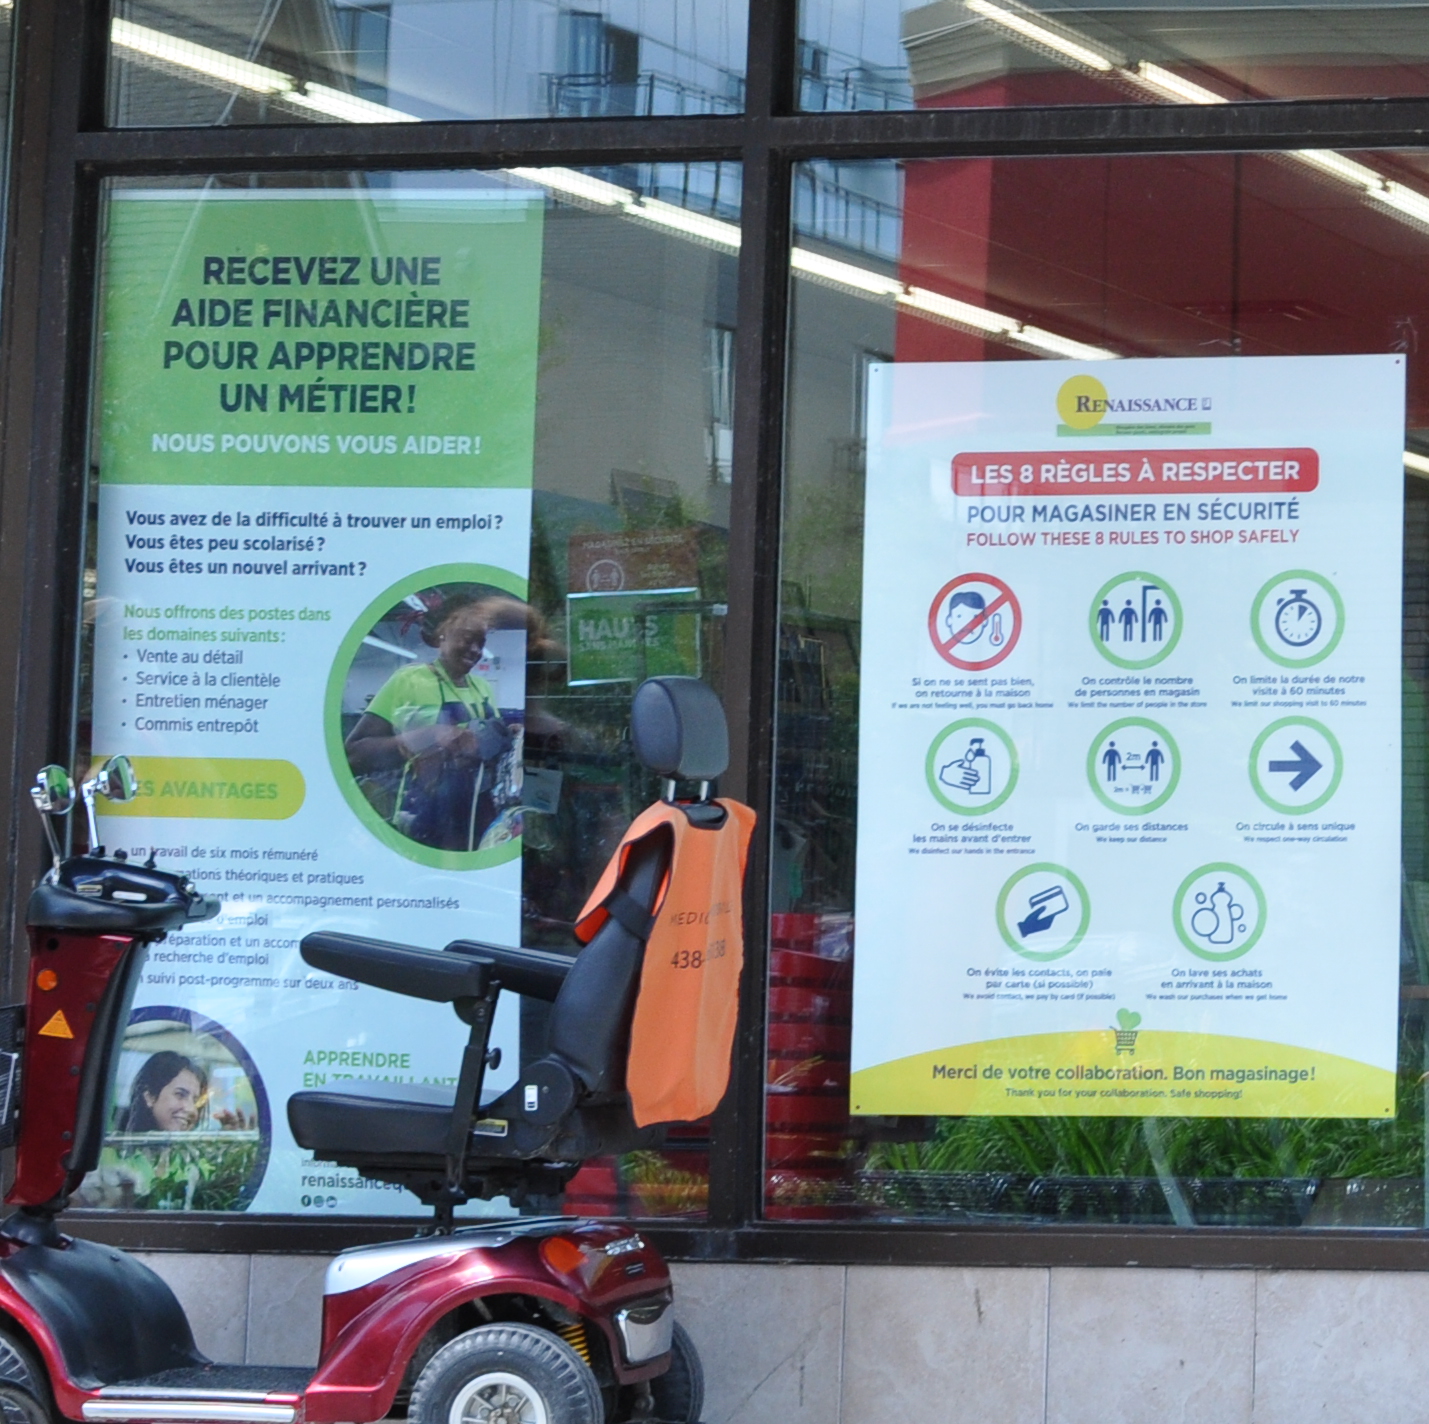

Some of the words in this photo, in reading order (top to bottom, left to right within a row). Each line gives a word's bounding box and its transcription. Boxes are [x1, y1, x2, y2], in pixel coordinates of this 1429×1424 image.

[204, 257, 360, 285] RECEVEZ
[371, 257, 440, 286] UNE
[171, 298, 253, 327] AIDE
[263, 291, 469, 328] FINANCIÈRE
[164, 341, 258, 370] POUR
[267, 341, 475, 370] APPRENDRE
[220, 384, 268, 412] UN
[1075, 395, 1197, 413] RENAISSANCE
[153, 434, 215, 452] NOUS
[222, 434, 330, 453] POUVONS
[336, 435, 397, 454] VOUS
[971, 465, 1013, 486] LES
[1020, 465, 1033, 483] 8
[1041, 461, 1130, 482] RÈGLES
[1138, 460, 1154, 481] À
[1163, 461, 1299, 481] RESPECTER
[968, 506, 1024, 523] POUR
[1032, 504, 1156, 522] MAGASINER
[1164, 503, 1190, 521] EN
[1198, 497, 1299, 520] SÉCURITÉ
[126, 511, 165, 525] Vous
[170, 514, 207, 526] avez
[212, 512, 231, 526] de
[237, 512, 250, 526] la
[256, 512, 328, 527] difficulté
[333, 512, 342, 527] à
[347, 514, 406, 528] trouver
[411, 518, 430, 528] un
[126, 534, 164, 549] Vous
[170, 534, 203, 550] êtes
[208, 539, 238, 552] peu
[967, 532, 1036, 546] FOLLOW
[1041, 532, 1090, 545] THESE
[1096, 532, 1104, 545] 8
[1110, 531, 1158, 544] RULES
[1164, 531, 1185, 544] TO
[1191, 530, 1233, 544] SHOP
[1239, 529, 1299, 543] SAFELY
[125, 558, 164, 573] Vous
[169, 558, 202, 574] êtes
[208, 563, 227, 574] un
[233, 560, 287, 574] nouvel
[124, 605, 160, 618] Nous
[164, 605, 215, 619] offrons
[219, 606, 244, 620] des
[248, 608, 295, 622] postes
[299, 607, 331, 621] dans
[122, 627, 142, 640] les
[147, 627, 217, 642] domaines
[578, 615, 659, 641] HAUS
[137, 649, 178, 663] Vente
[182, 653, 198, 663] au
[203, 650, 243, 664] détail
[136, 671, 188, 686] Service
[192, 672, 200, 686] à
[205, 672, 216, 686] la
[221, 673, 280, 687] clientèle
[912, 678, 921, 686] Si
[968, 678, 988, 686] sent
[991, 679, 1007, 687] pas
[1011, 678, 1034, 686] bien,
[1082, 677, 1096, 685] On
[1099, 676, 1140, 685] contrôle
[1090, 690, 1141, 698] personnes
[1159, 688, 1200, 698] magasin
[136, 693, 200, 708] Entretien
[205, 695, 268, 712] ménager
[135, 717, 193, 731] Commis
[197, 718, 258, 733] entrepôt
[160, 782, 278, 800] AVANTAGES
[132, 848, 145, 856] un
[191, 846, 206, 858] de
[210, 847, 226, 858] six
[230, 848, 259, 859] mois
[262, 848, 318, 861] rémunéré
[225, 869, 288, 883] théoriques
[292, 872, 303, 882] et
[308, 872, 364, 885] pratiques
[233, 892, 245, 900] et
[248, 892, 263, 901] un
[267, 894, 373, 908] accompagnement
[377, 897, 459, 909] personnalisés
[154, 951, 213, 963] recherche
[217, 952, 268, 966] d'emploi
[147, 972, 175, 984] suivi
[179, 975, 279, 988] post-programme
[284, 979, 302, 988] sur
[303, 976, 331, 989] deux
[337, 976, 358, 990] ans
[304, 1050, 410, 1068] APPRENDRE
[304, 1073, 326, 1088] EN
[933, 1064, 977, 1079] Merci
[983, 1065, 1002, 1079] de
[1008, 1066, 1051, 1083] votre
[1055, 1065, 1167, 1083] collaboration.
[1173, 1066, 1204, 1080] Bon
[1005, 1088, 1034, 1097] Thank
[1038, 1090, 1056, 1099] you
[1059, 1088, 1073, 1097] for
[1076, 1090, 1097, 1099] your
[1100, 1088, 1166, 1098] collaboration.
[1170, 1088, 1191, 1098] Safe
[1194, 1088, 1243, 1100] shopping!
